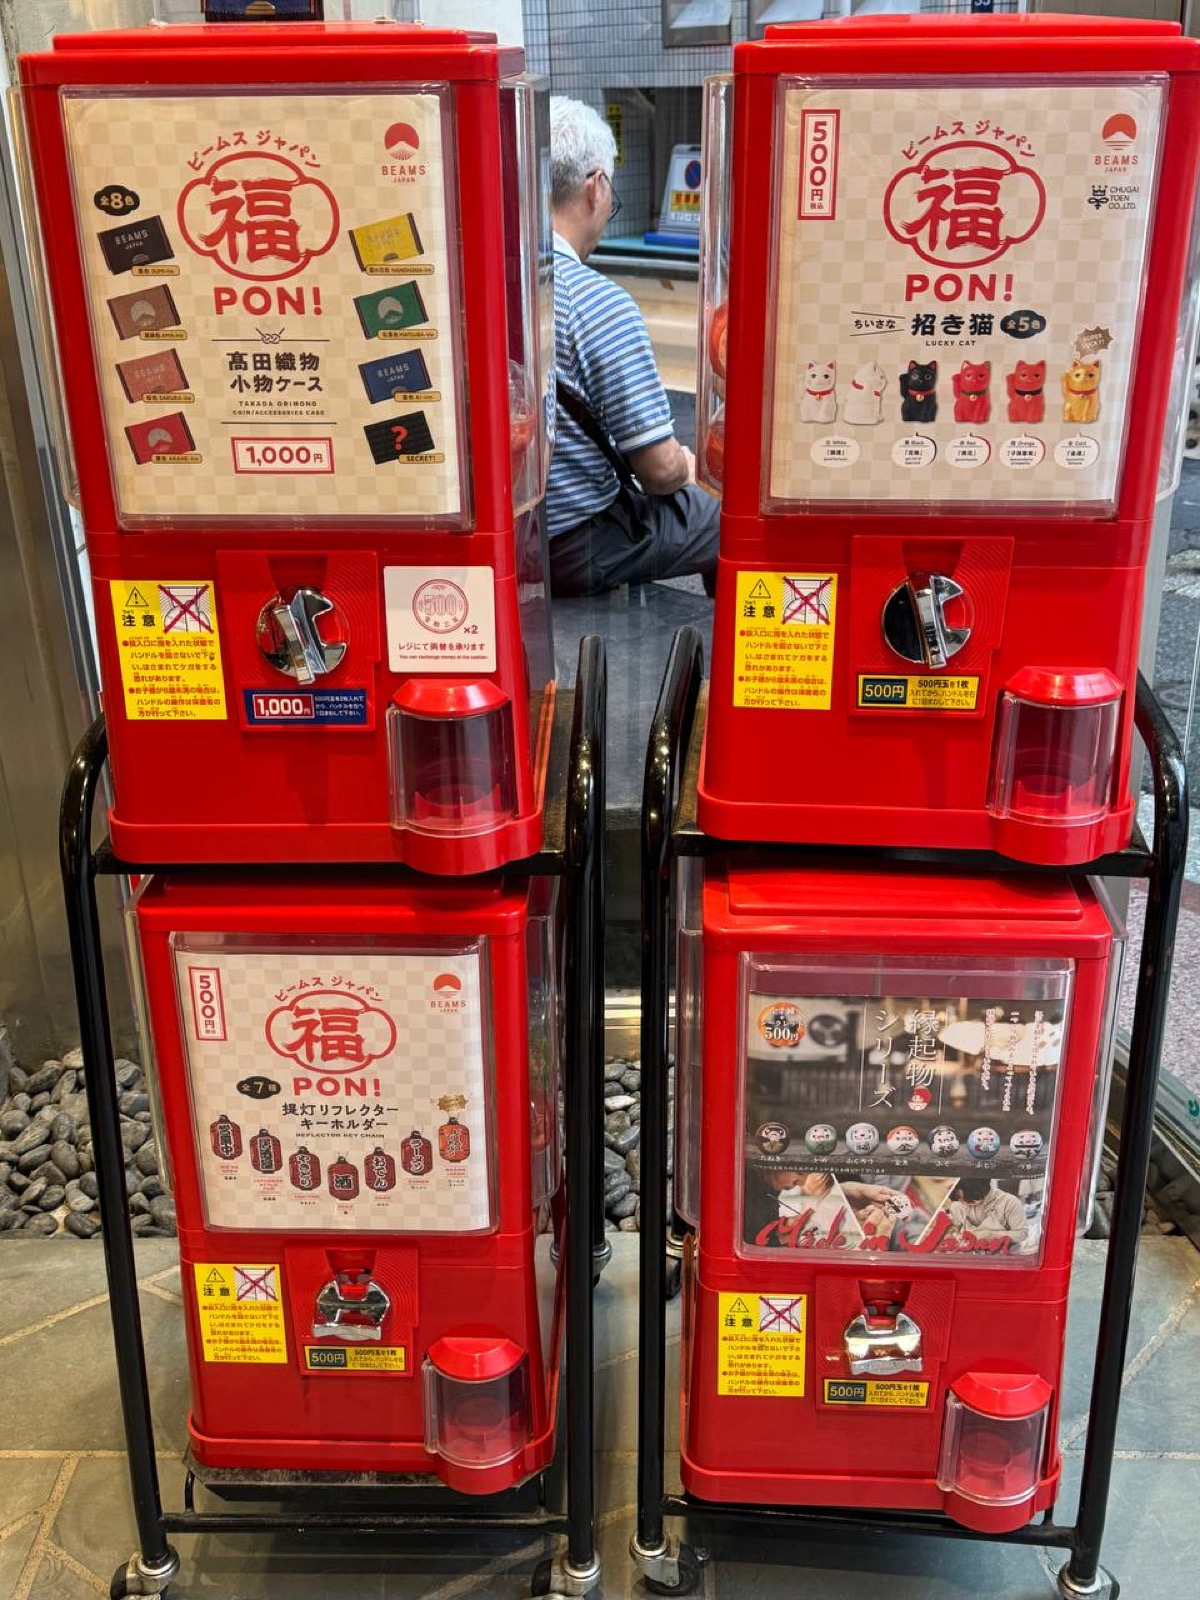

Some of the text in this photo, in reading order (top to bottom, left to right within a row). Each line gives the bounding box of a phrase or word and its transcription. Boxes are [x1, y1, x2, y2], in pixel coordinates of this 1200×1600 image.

[902, 119, 1036, 160] ビームス ジャパン
[187, 130, 321, 171] ビームス ジャパン
[1094, 155, 1139, 165] BEAMS
[381, 164, 426, 176] BEAMS
[809, 121, 828, 201] 500円
[900, 165, 1008, 252] 福
[200, 176, 302, 265] 福
[114, 229, 149, 246] BEAMS
[905, 273, 1014, 302] PON!
[213, 285, 323, 316] PON!
[854, 319, 896, 329] ちいさな
[911, 313, 995, 336] 招き猫
[376, 363, 410, 378] BEAMS
[230, 374, 323, 393] 小物ケース
[245, 446, 323, 467] 1,000円
[122, 614, 156, 627] 注意
[744, 605, 775, 618] 注意
[865, 684, 904, 698] 500円
[257, 698, 311, 717] 1,000円
[275, 976, 384, 1002] ビームス ジャパン
[199, 974, 216, 1029] 500円
[430, 1000, 466, 1008] BEAMS
[283, 1006, 364, 1063] 福
[905, 1009, 939, 1087] 縁起物
[869, 1009, 900, 1108] シリーズ
[293, 1078, 381, 1096] PON!
[282, 1103, 400, 1117] 提灯リフレクター
[301, 1118, 389, 1131] キーホルダー
[373, 1155, 387, 1188] おでん
[755, 1206, 1011, 1255] Made in Japan
[204, 1287, 230, 1296] 注意
[725, 1318, 753, 1327] 注意
[312, 1352, 345, 1363] 500円
[830, 1385, 865, 1397] 500円
